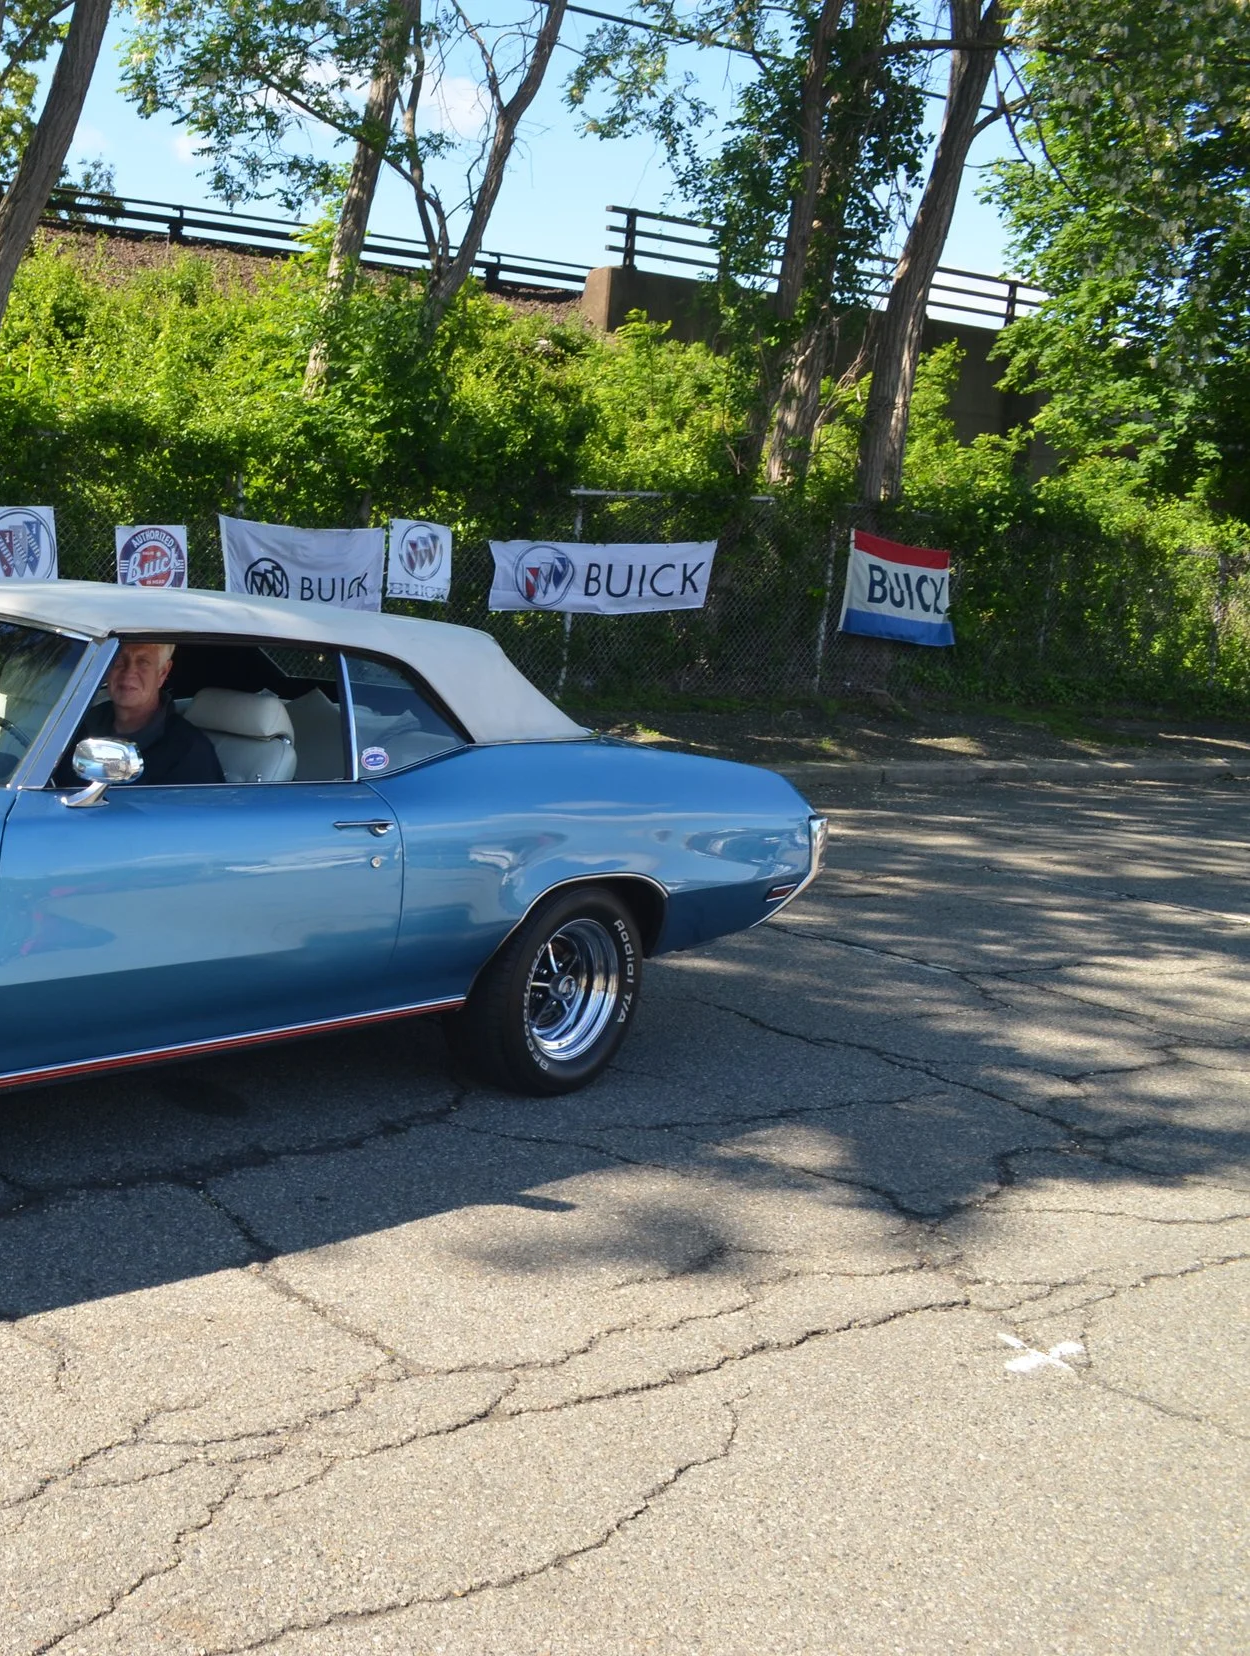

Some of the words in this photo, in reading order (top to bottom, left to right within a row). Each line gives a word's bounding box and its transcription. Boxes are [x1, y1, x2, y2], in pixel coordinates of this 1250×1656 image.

[131, 530, 175, 548] AUTHORIZED
[127, 547, 181, 583] Buick
[584, 561, 706, 598] BUICK
[301, 573, 368, 602] BUICK
[387, 582, 449, 601] BUICK
[614, 919, 635, 984] Radial
[616, 992, 634, 1023] T/A
